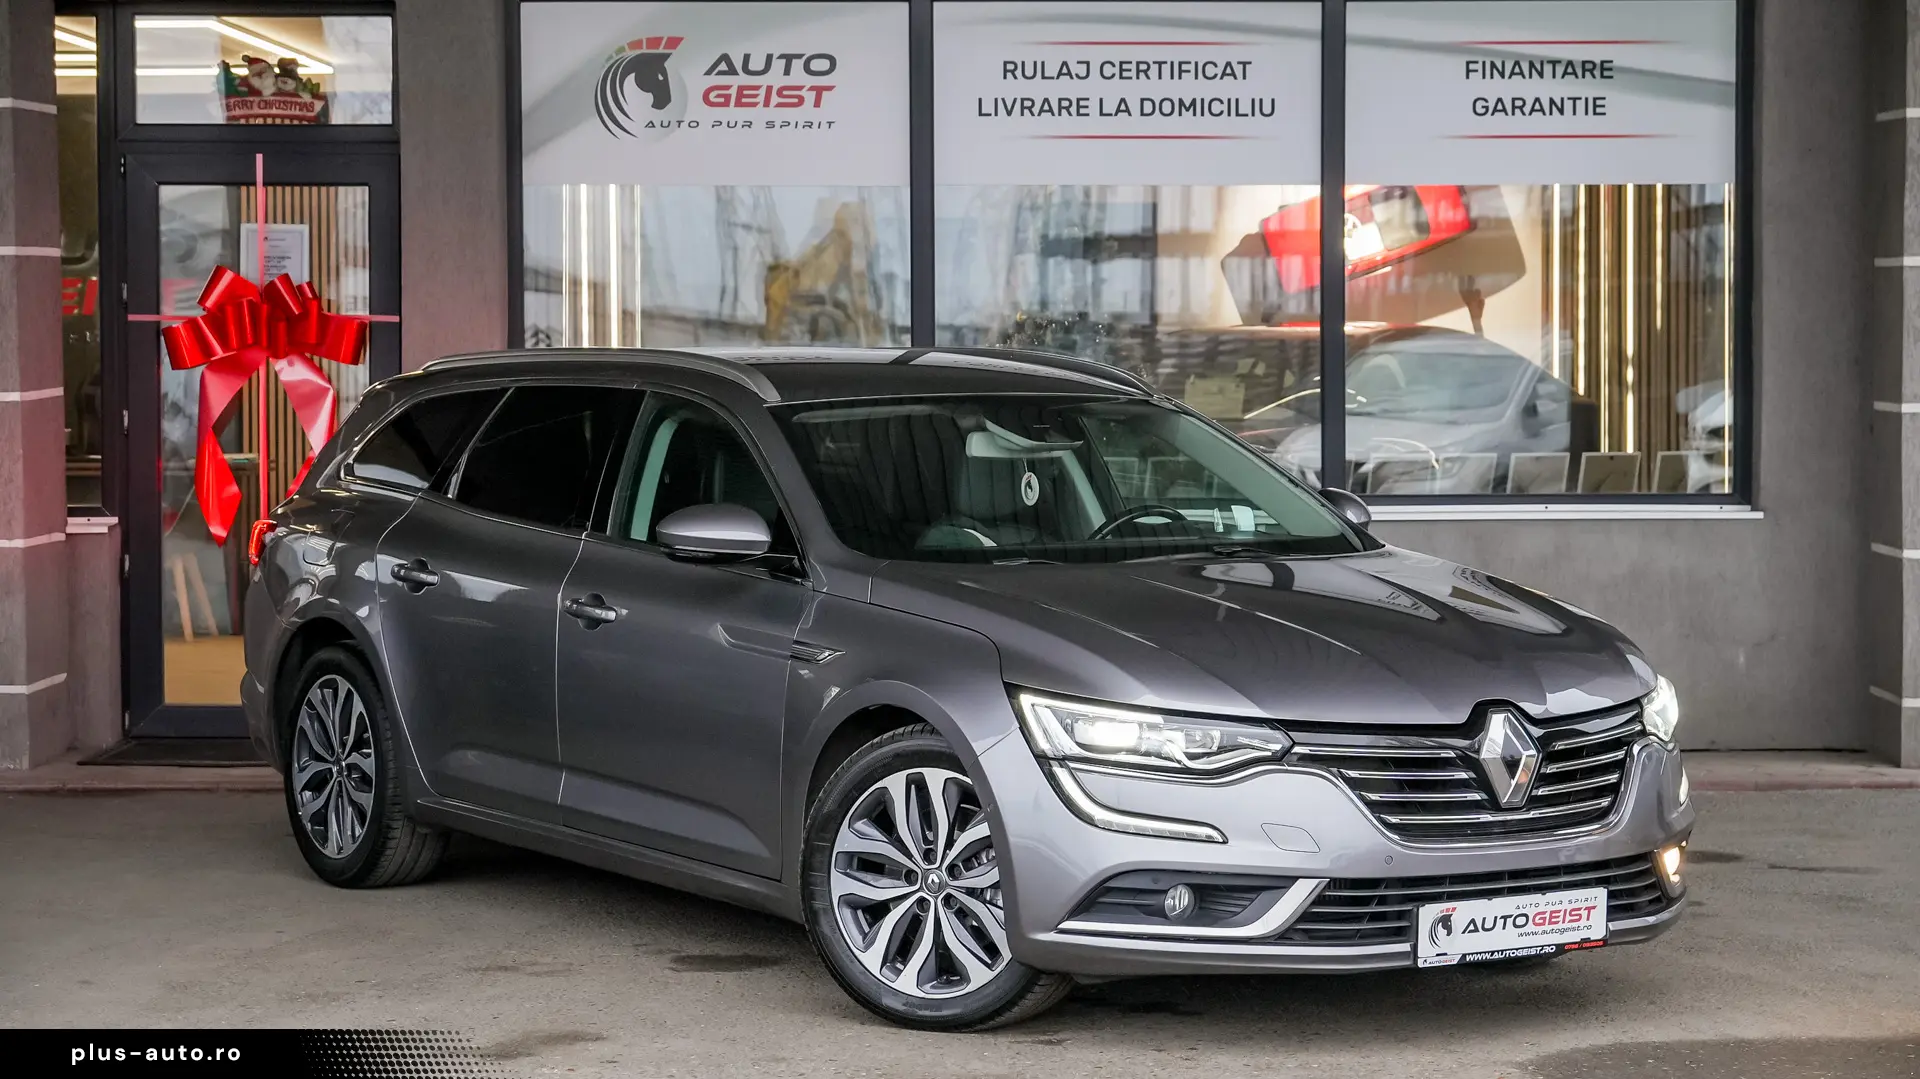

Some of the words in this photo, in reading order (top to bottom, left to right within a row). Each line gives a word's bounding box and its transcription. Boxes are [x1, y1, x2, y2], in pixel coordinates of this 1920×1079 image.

[703, 53, 837, 77] AUTO
[1002, 61, 1092, 80] RULAJ
[1099, 61, 1253, 80] CERTIFICAT
[1465, 60, 1614, 80] FINANTARE
[702, 84, 837, 108] GEIST
[225, 100, 255, 112] ERRY
[257, 99, 315, 113] CHRISTMAS
[977, 97, 1091, 117] LIVRARE
[1099, 97, 1133, 117] LA
[1139, 97, 1276, 117] DOMICILIU
[1472, 97, 1607, 117] GARANTIE
[644, 120, 700, 129] AUTO
[711, 120, 753, 129] PUR
[764, 120, 836, 130] SPIRIT
[1515, 902, 1540, 910] AUTO
[1568, 896, 1598, 905] SPIRIT
[1461, 905, 1597, 935] AUTOGEIST
[1517, 924, 1593, 938] www.autogeist.ro
[1466, 945, 1556, 962] WWW.AUTOGEIST.RO
